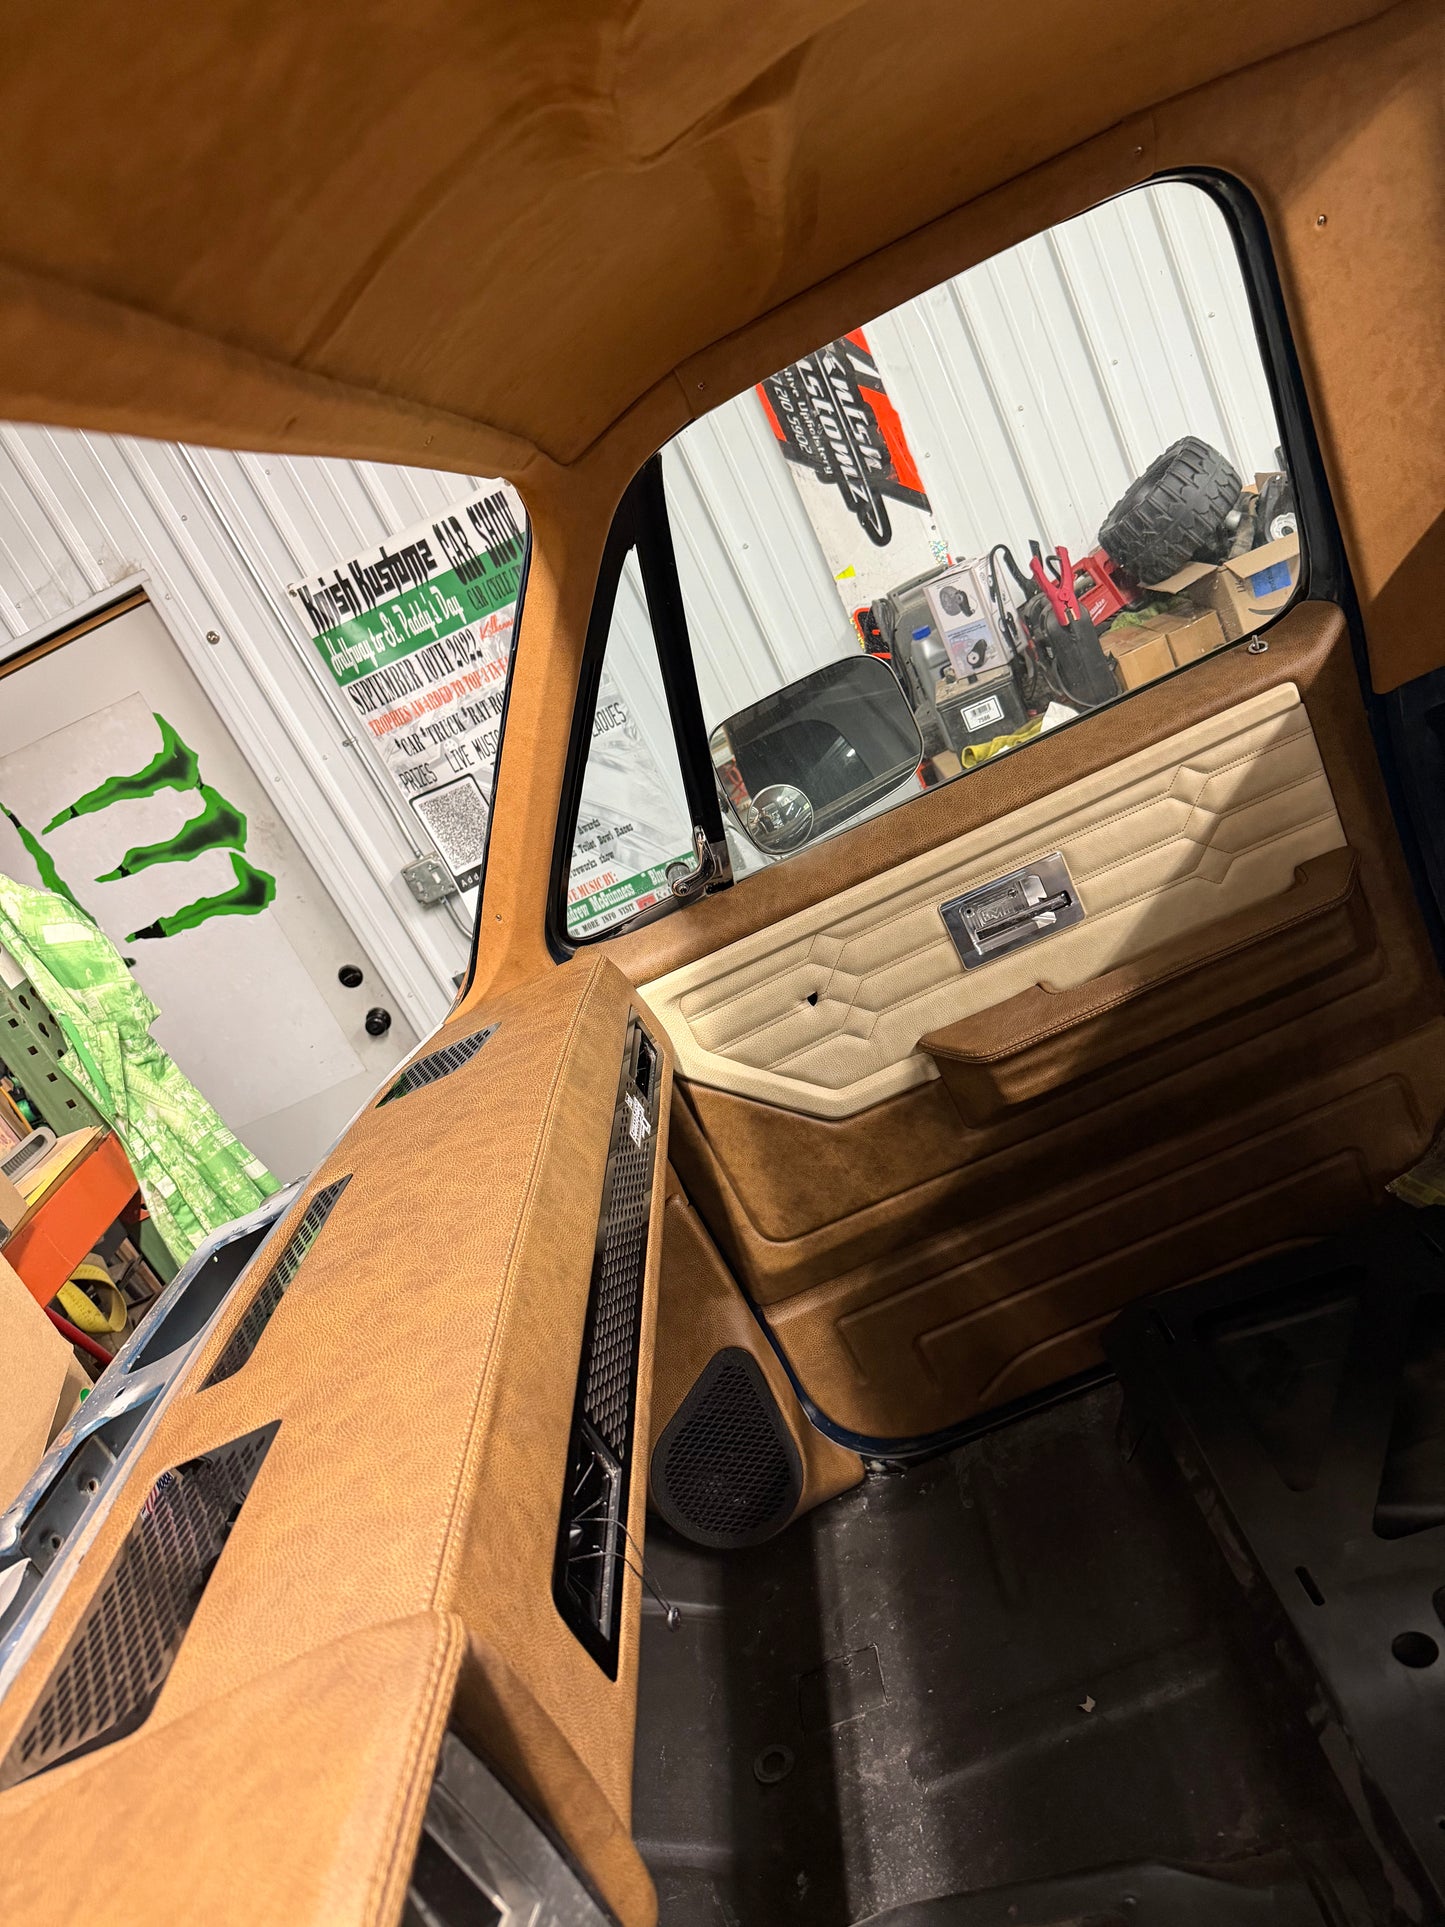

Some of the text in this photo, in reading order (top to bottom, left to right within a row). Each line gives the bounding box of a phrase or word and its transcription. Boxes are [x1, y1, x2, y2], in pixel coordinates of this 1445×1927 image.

[774, 386, 795, 413] 210
[785, 416, 813, 455] 5902
[798, 401, 834, 475] Upholstery
[298, 569, 364, 638] Knish
[432, 515, 487, 586] CAR
[466, 490, 525, 569] SHOW
[466, 585, 489, 611] CAR
[323, 585, 467, 677] Halfway to St. Paddy's Day
[348, 658, 424, 715] SEPTEMBER
[415, 642, 456, 683] 10TH
[446, 628, 483, 668] 2022
[368, 705, 413, 737] TROPHIES
[411, 683, 453, 718] AWARDED
[450, 678, 464, 698] TO
[463, 671, 481, 693] TOP
[486, 661, 501, 680] IN
[488, 690, 504, 715] RO
[592, 702, 627, 738] AQUES
[398, 762, 438, 794] PRIZES
[444, 745, 475, 773] LIVE
[597, 831, 614, 845] Bowl
[570, 859, 598, 878] ireworks
[577, 875, 604, 898] MUSIC
[602, 871, 619, 887] BY:
[589, 883, 636, 912] McGuinness
[582, 920, 600, 932] MORE
[601, 912, 617, 924] INFO
[618, 903, 636, 916] VISIT
